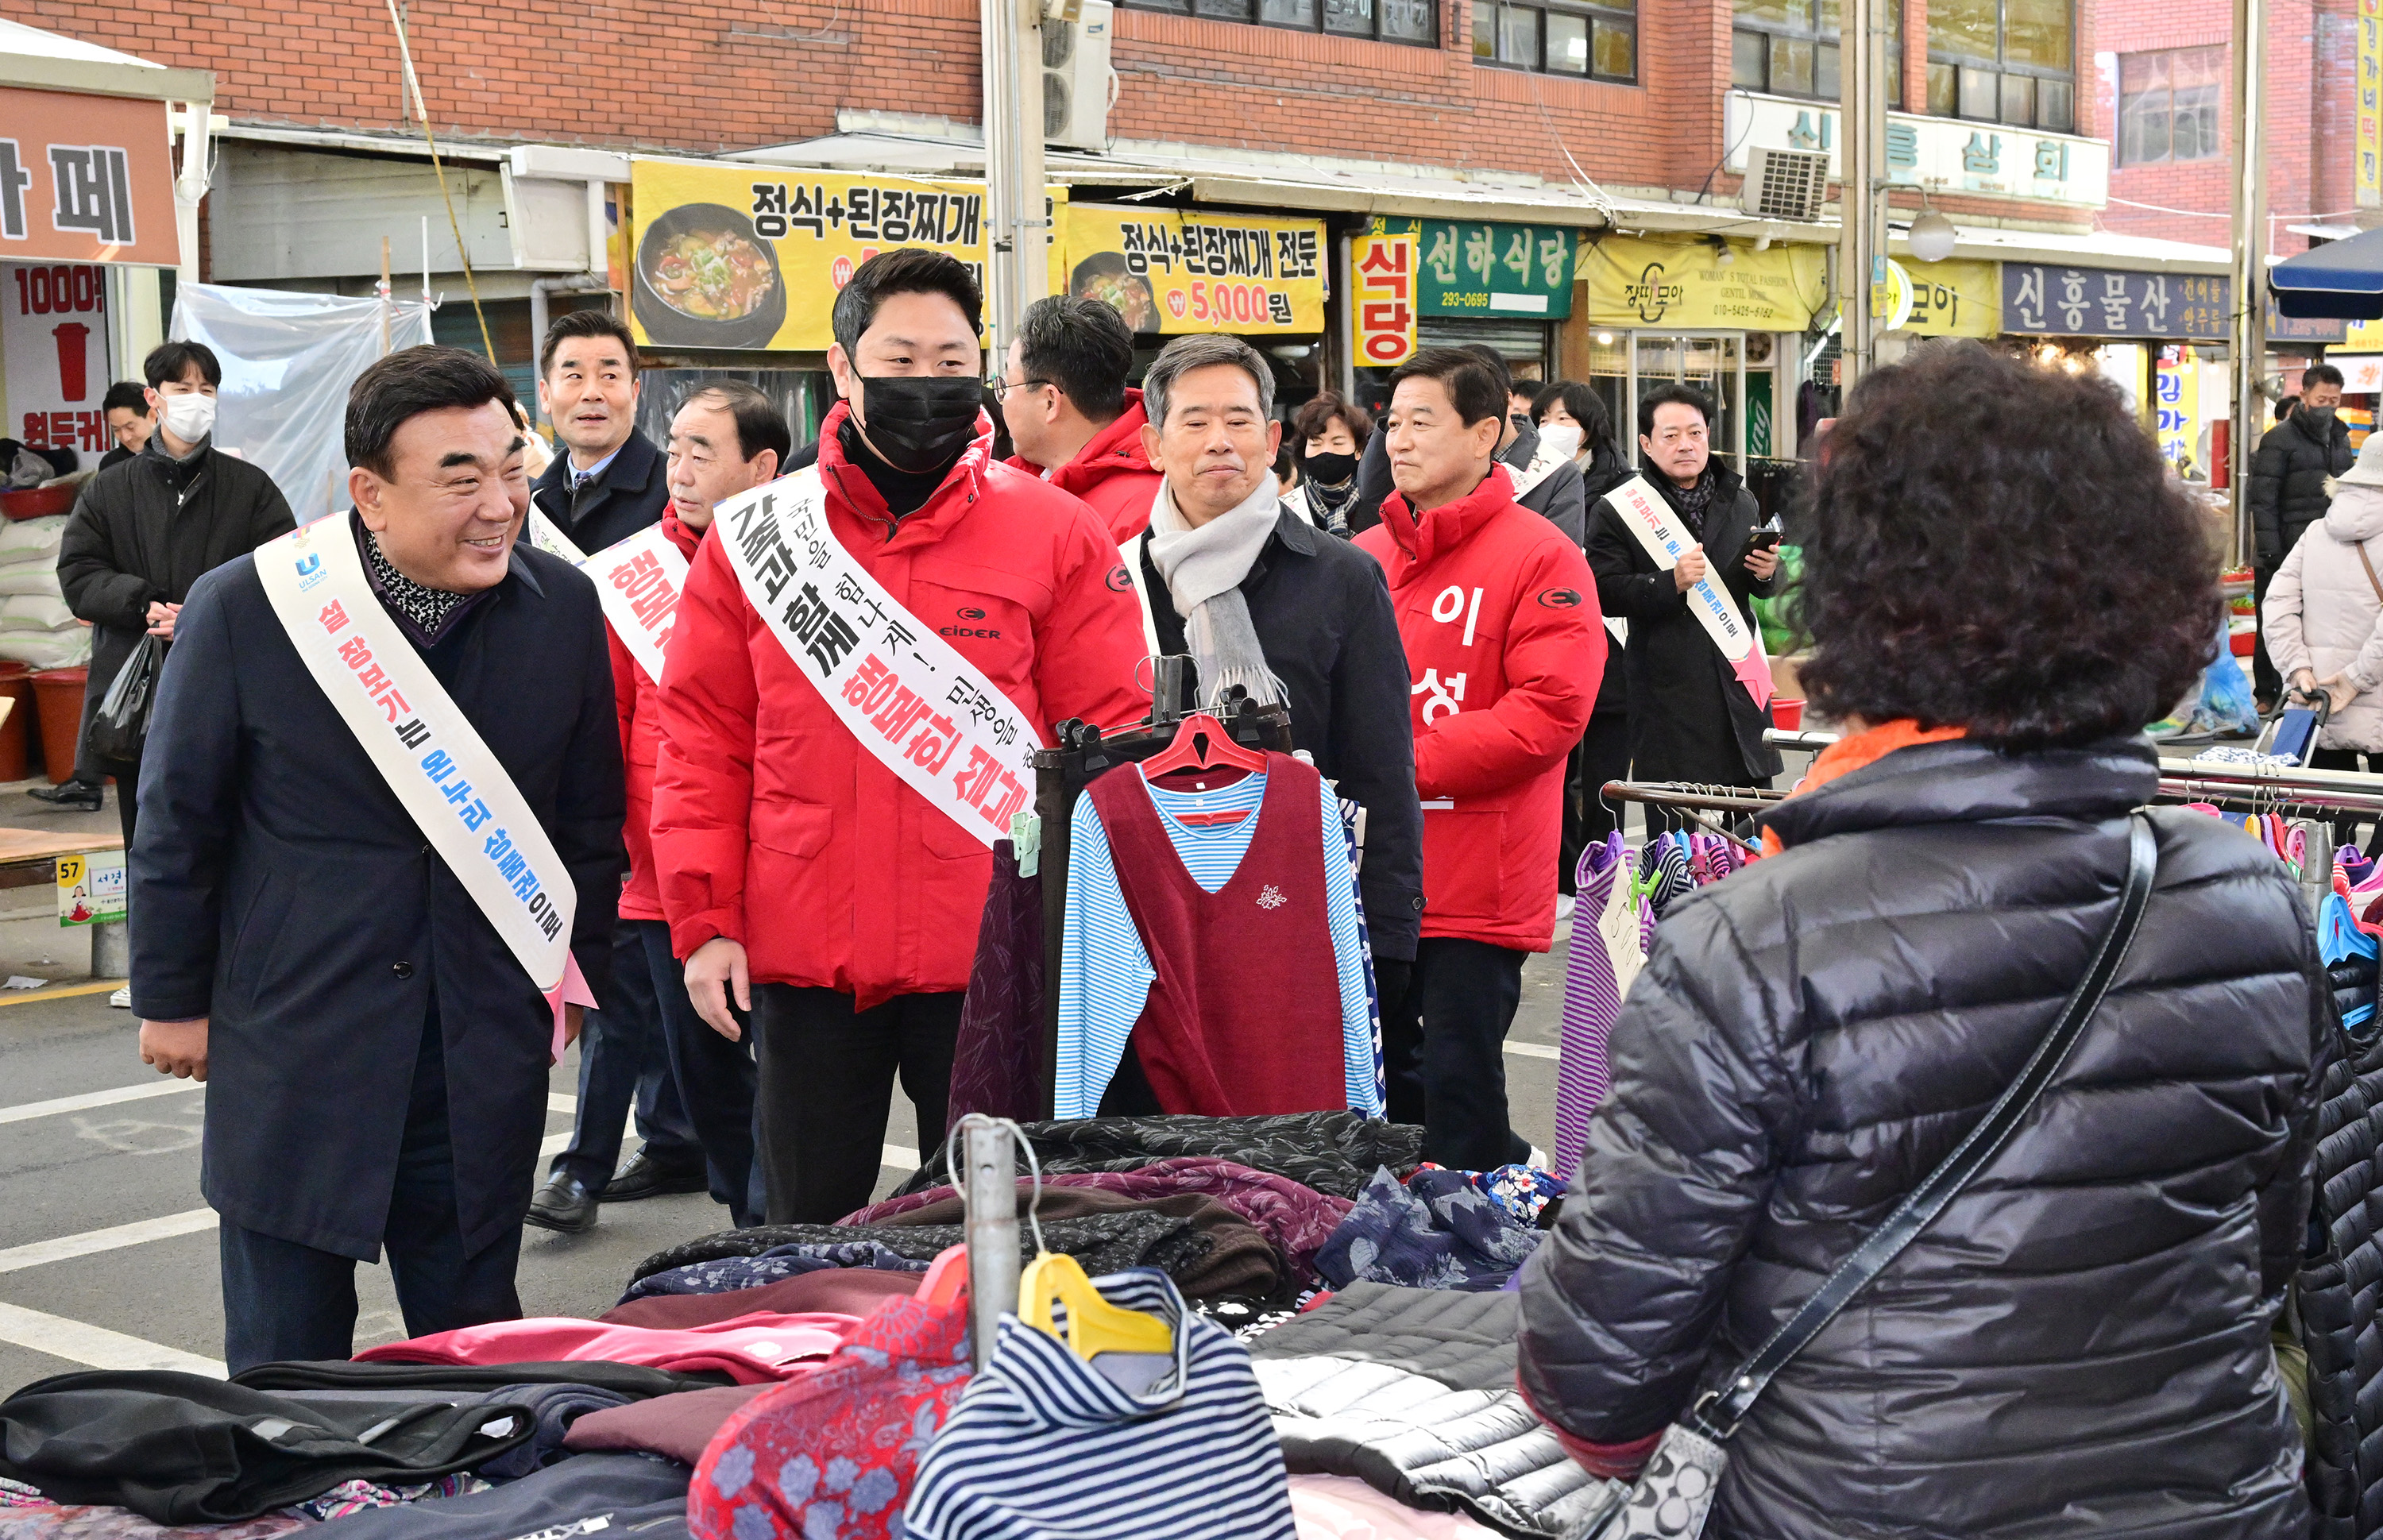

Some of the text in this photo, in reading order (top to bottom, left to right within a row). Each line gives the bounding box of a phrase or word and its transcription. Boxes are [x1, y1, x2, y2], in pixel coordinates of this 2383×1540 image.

[752, 183, 980, 245] 정식+된장찌개
[1120, 222, 1318, 280] 정식+된장찌개 전문
[1426, 225, 1569, 289] 선하식당
[1736, 272, 1757, 285] TOTAL
[1759, 275, 1788, 287] FASHION
[1360, 242, 1412, 361] 식당
[1442, 291, 1489, 307] 293-0695
[2014, 267, 2171, 334] 신흥물산
[24, 410, 110, 451] 원두커
[1631, 496, 1670, 542] 장보기는
[299, 569, 327, 589] ULSAN
[788, 497, 831, 569] 국민을
[834, 572, 936, 673] 힘나게!
[945, 676, 1018, 747] 민생을
[731, 492, 1030, 834] 가족과 함께 행복한 설날
[318, 598, 566, 944] 설 장보기는 온누리 상품권으로
[61, 862, 79, 879] 57
